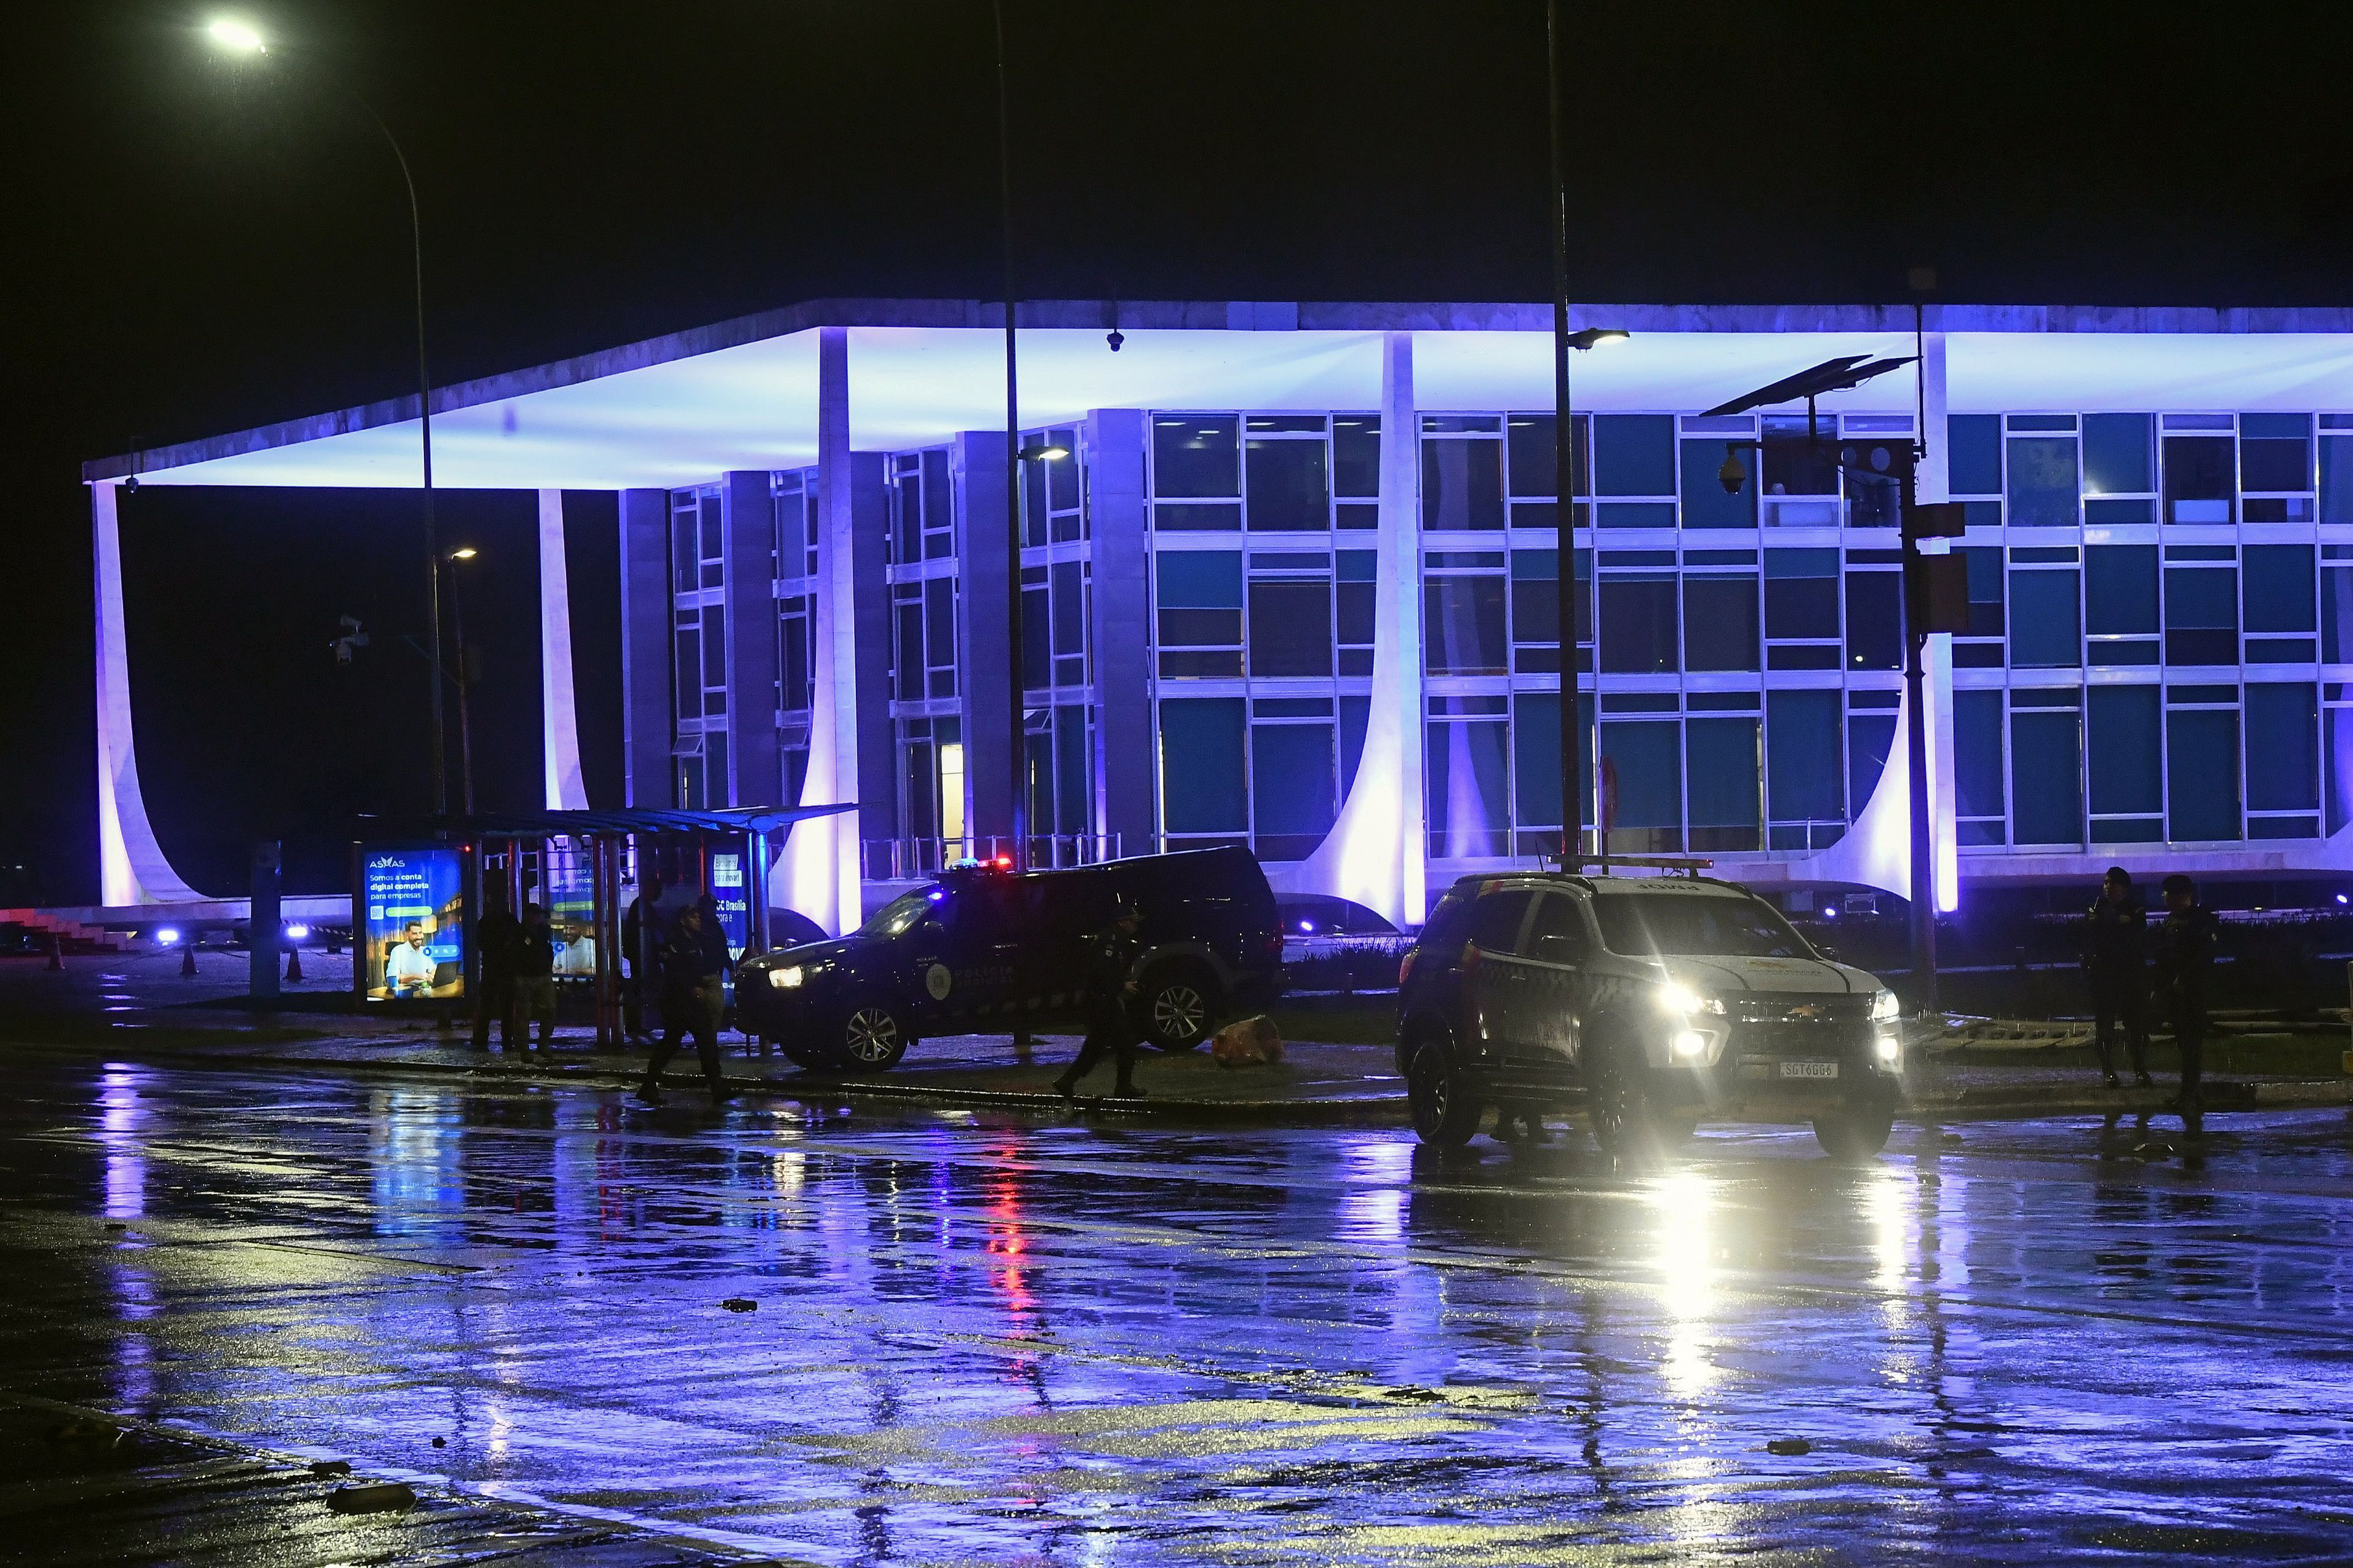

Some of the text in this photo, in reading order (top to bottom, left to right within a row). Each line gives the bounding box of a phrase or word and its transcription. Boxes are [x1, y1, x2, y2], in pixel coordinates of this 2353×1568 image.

[370, 882, 429, 892] digital completa
[725, 898, 746, 911] Brasília
[729, 911, 732, 922] é
